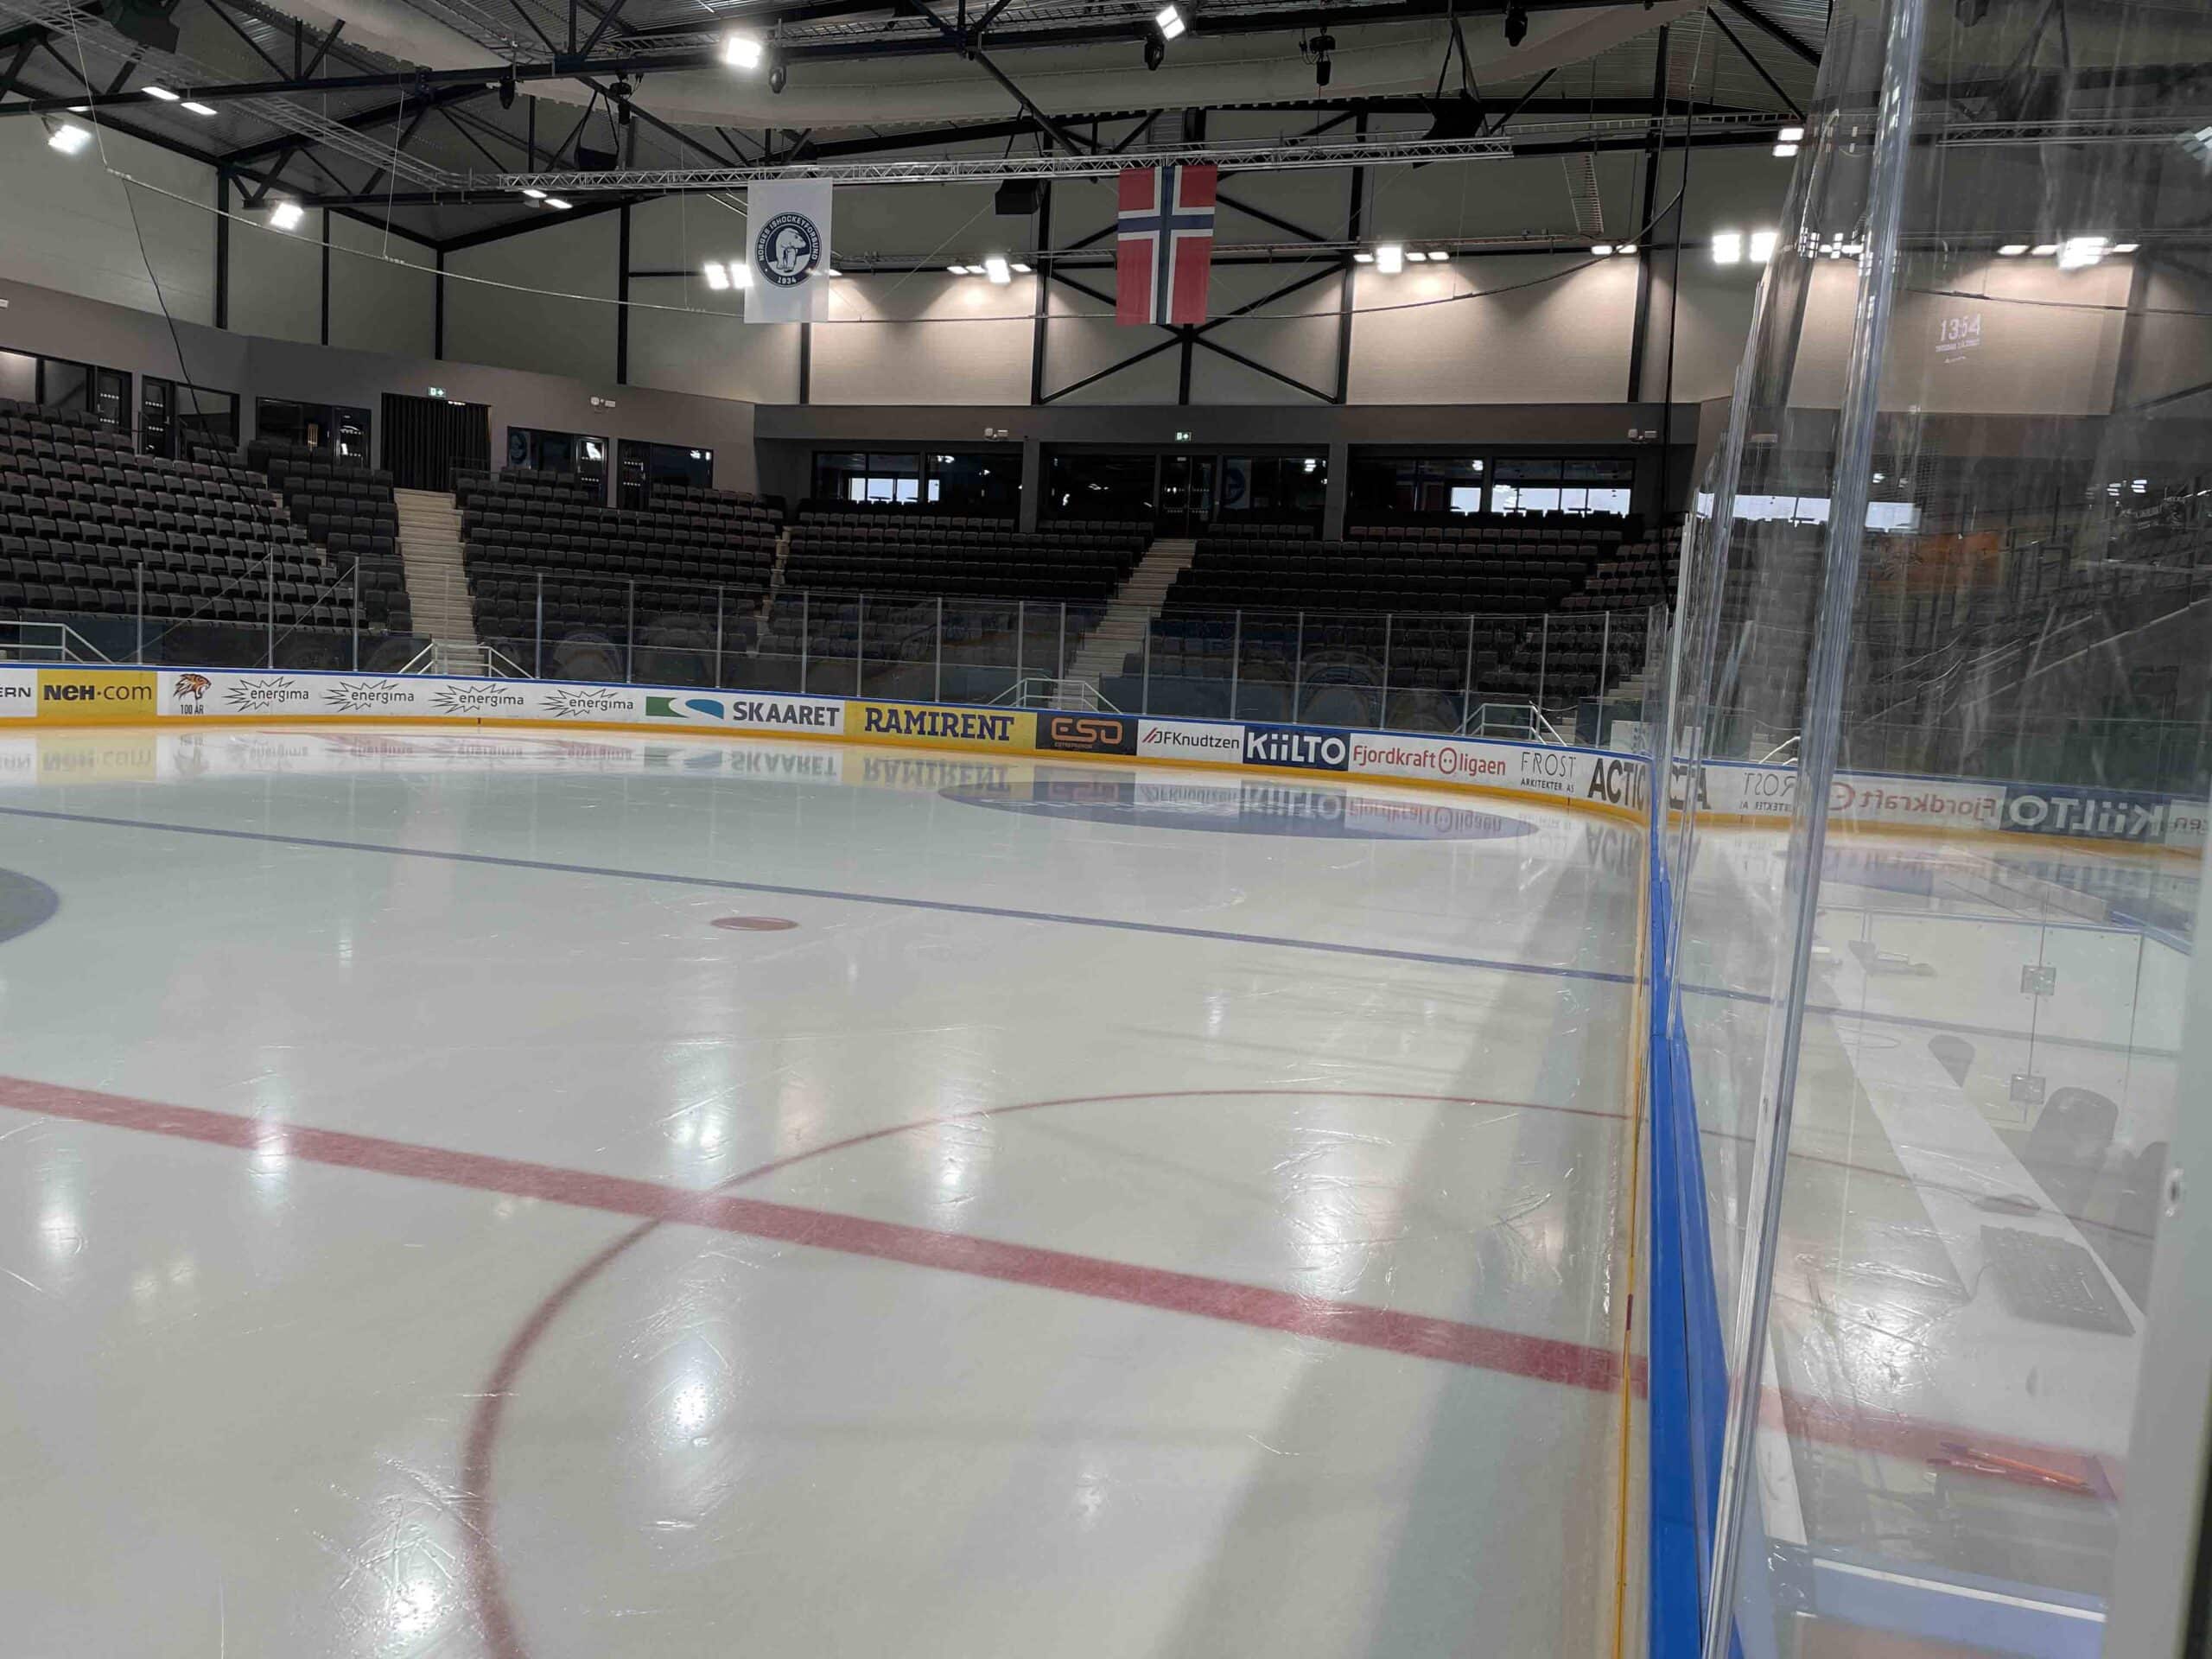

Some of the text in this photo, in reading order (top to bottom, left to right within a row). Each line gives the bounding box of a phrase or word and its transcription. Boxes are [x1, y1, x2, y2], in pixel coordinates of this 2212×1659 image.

[250, 689, 309, 702] energima
[351, 690, 415, 705] energima
[459, 693, 524, 708] energima
[180, 704, 193, 715] 100
[569, 697, 634, 712] energima
[733, 701, 840, 727] SKAARET
[864, 707, 1014, 741] RAMIRENT
[1246, 731, 1346, 766] KiiLTO
[1521, 751, 1577, 779] FROST
[1521, 778, 1562, 791] ARKITEKTER
